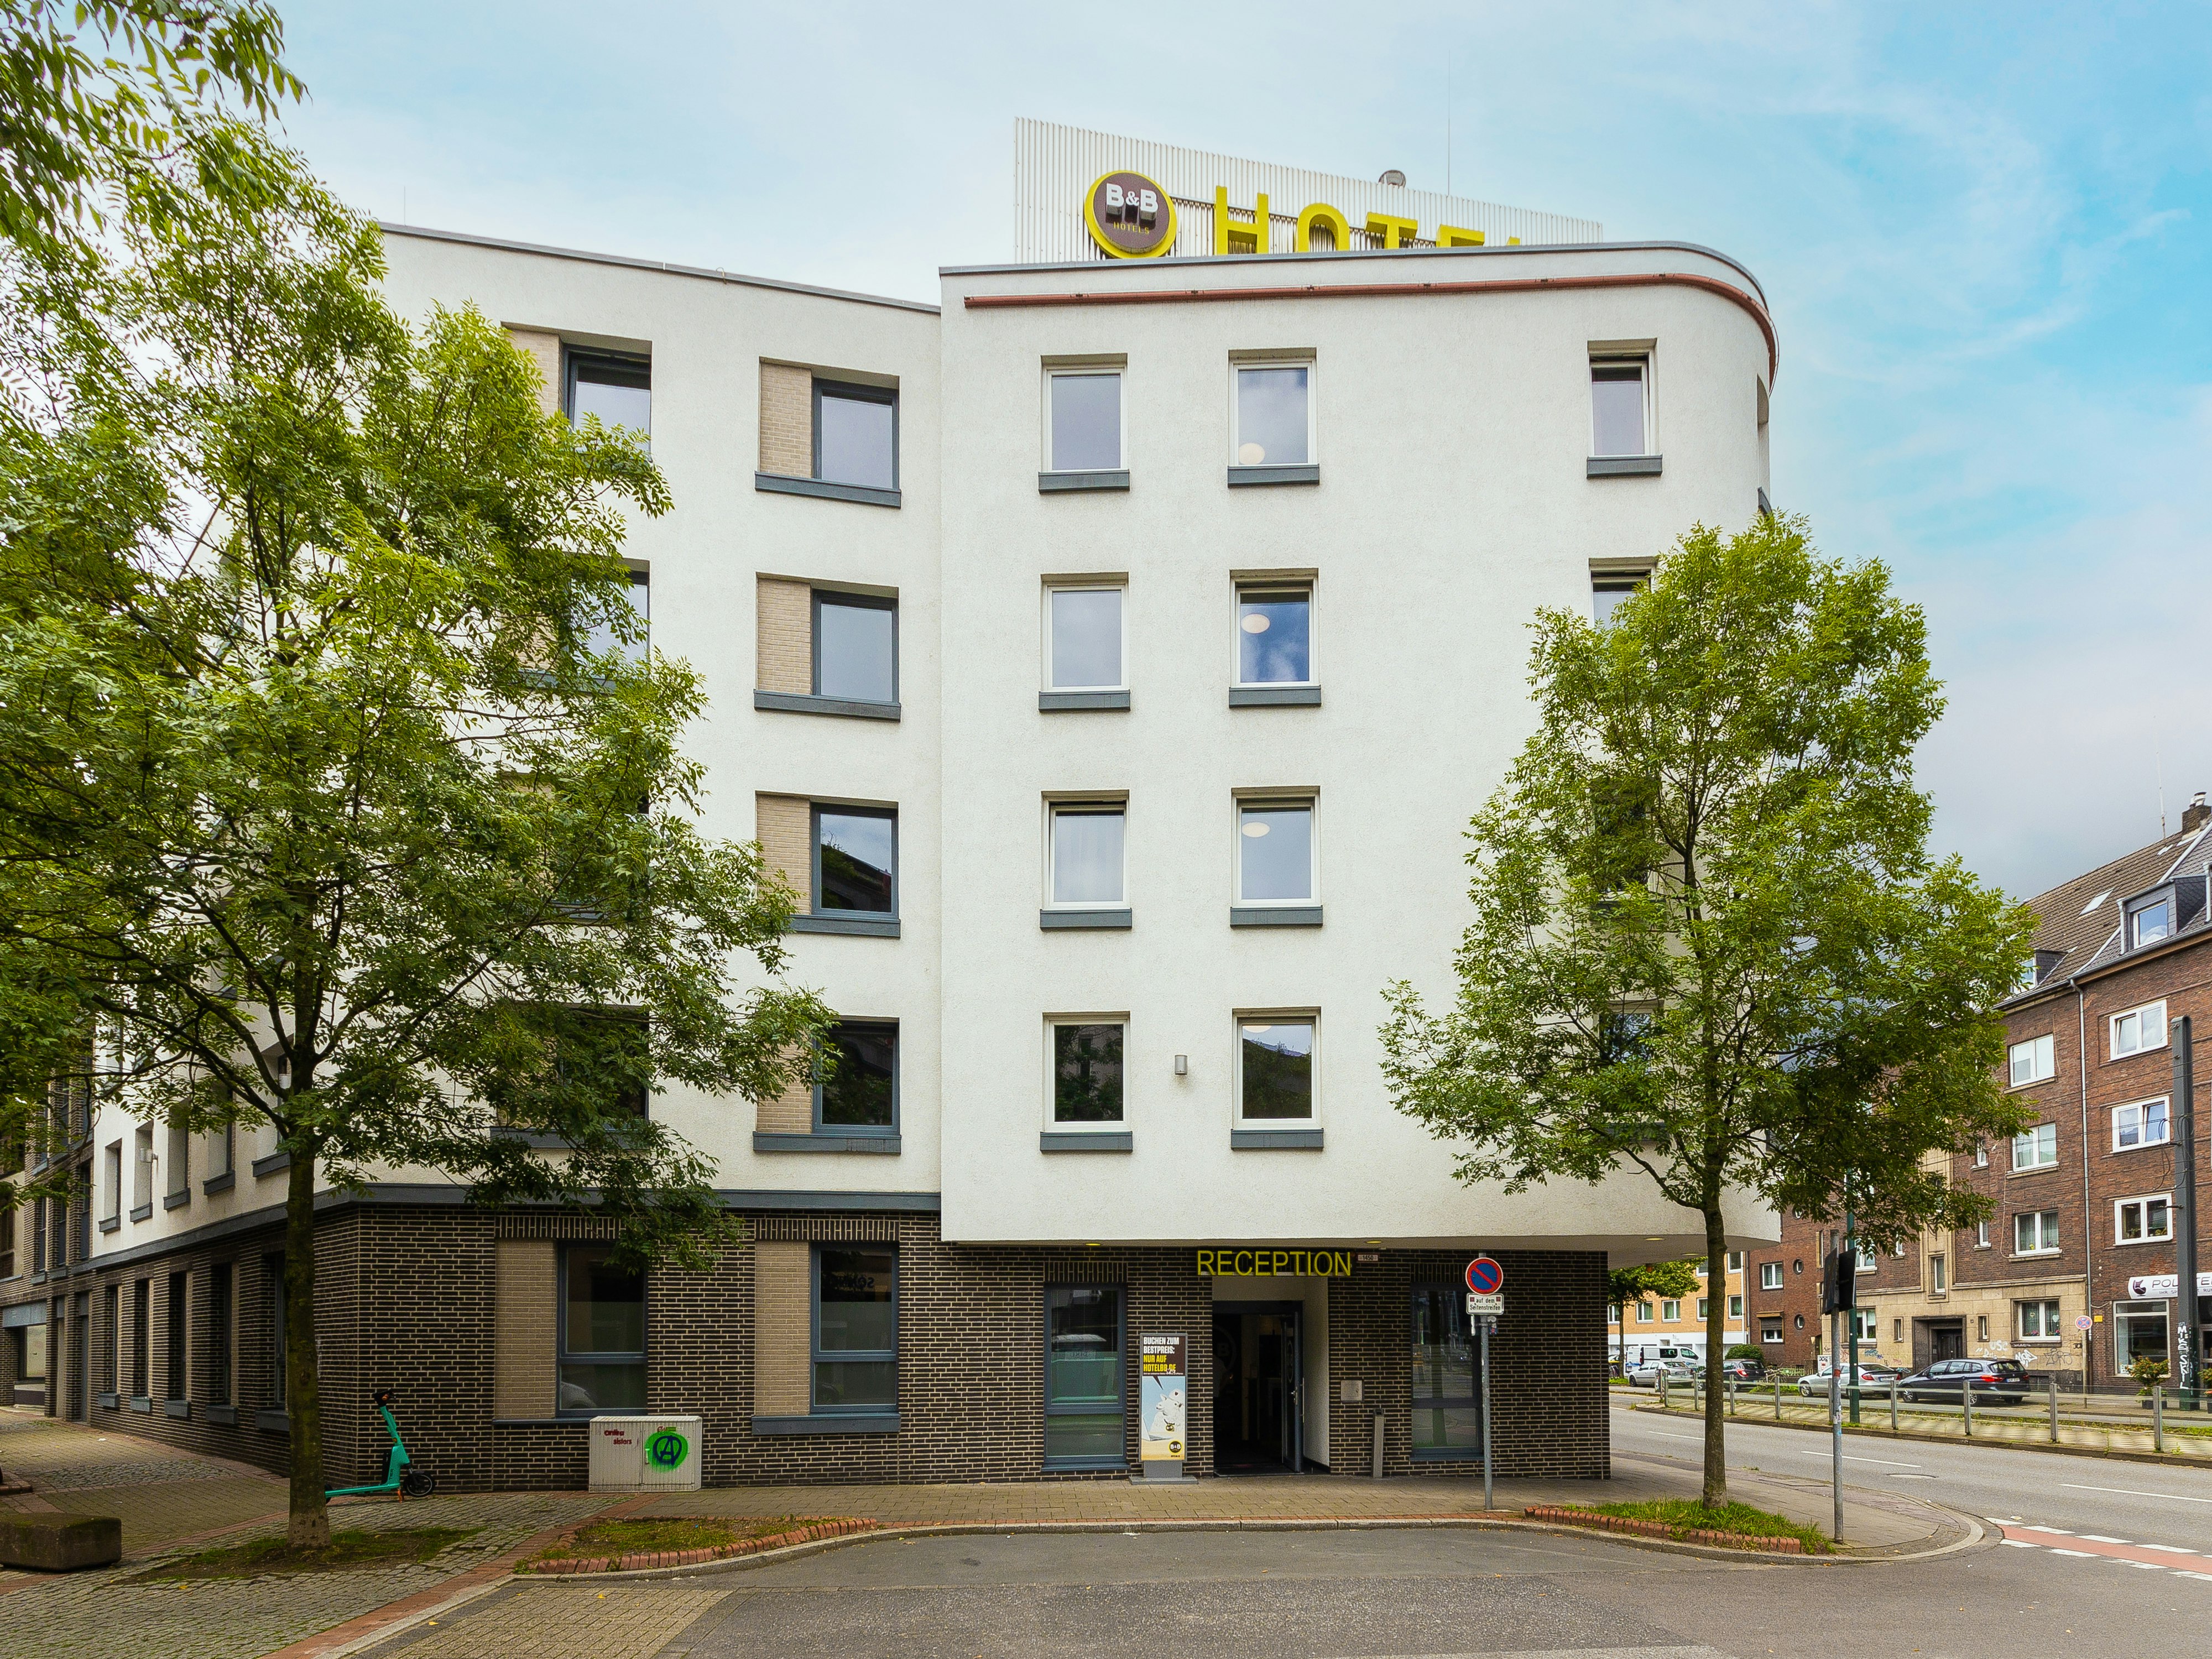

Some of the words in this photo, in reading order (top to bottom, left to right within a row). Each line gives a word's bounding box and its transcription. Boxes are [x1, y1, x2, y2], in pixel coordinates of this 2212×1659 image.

[1106, 182, 1159, 212] B&B
[1214, 185, 1521, 255] HOT
[1113, 221, 1150, 235] HOTELS
[1197, 1250, 1351, 1276] RECEPTION
[1143, 1337, 1166, 1345] BUCHEN
[1166, 1337, 1180, 1345] ZUM
[1143, 1345, 1175, 1354] BESTPREIS:
[1143, 1355, 1155, 1363] NUR
[1156, 1355, 1167, 1363] AUF
